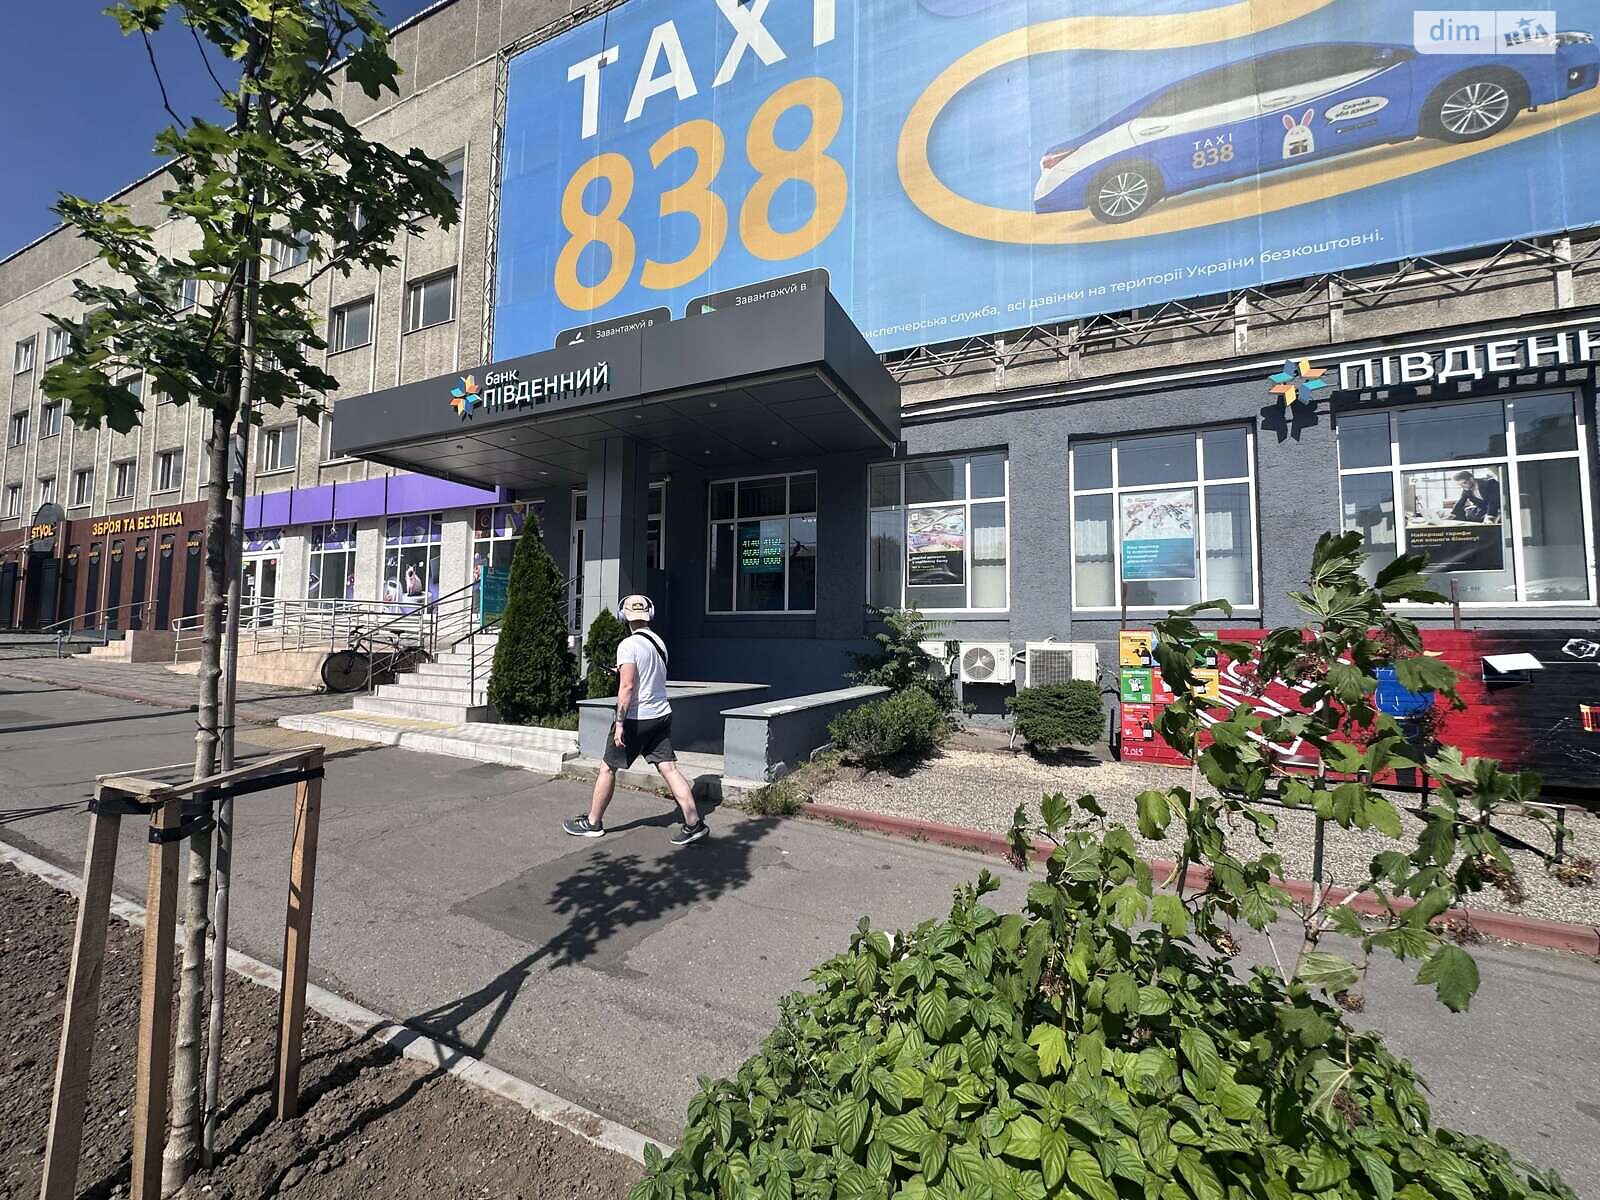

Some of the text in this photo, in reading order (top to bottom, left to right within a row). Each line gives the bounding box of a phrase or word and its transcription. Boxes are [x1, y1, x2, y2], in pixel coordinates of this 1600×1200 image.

[1192, 133, 1232, 150] TAXI
[1192, 144, 1235, 169] 838
[554, 77, 848, 311] 838
[1007, 299, 1026, 312] всі
[1029, 289, 1084, 310] дзвінки
[1089, 286, 1106, 297] на
[1109, 269, 1183, 293] території
[1186, 257, 1255, 279] України
[1260, 229, 1385, 263] безкоштовні.
[482, 360, 609, 408] ПІВДЕННИЙ
[485, 369, 518, 386] банк
[92, 511, 183, 536] ЗБРОЯ ТА БЕЗПЕКА
